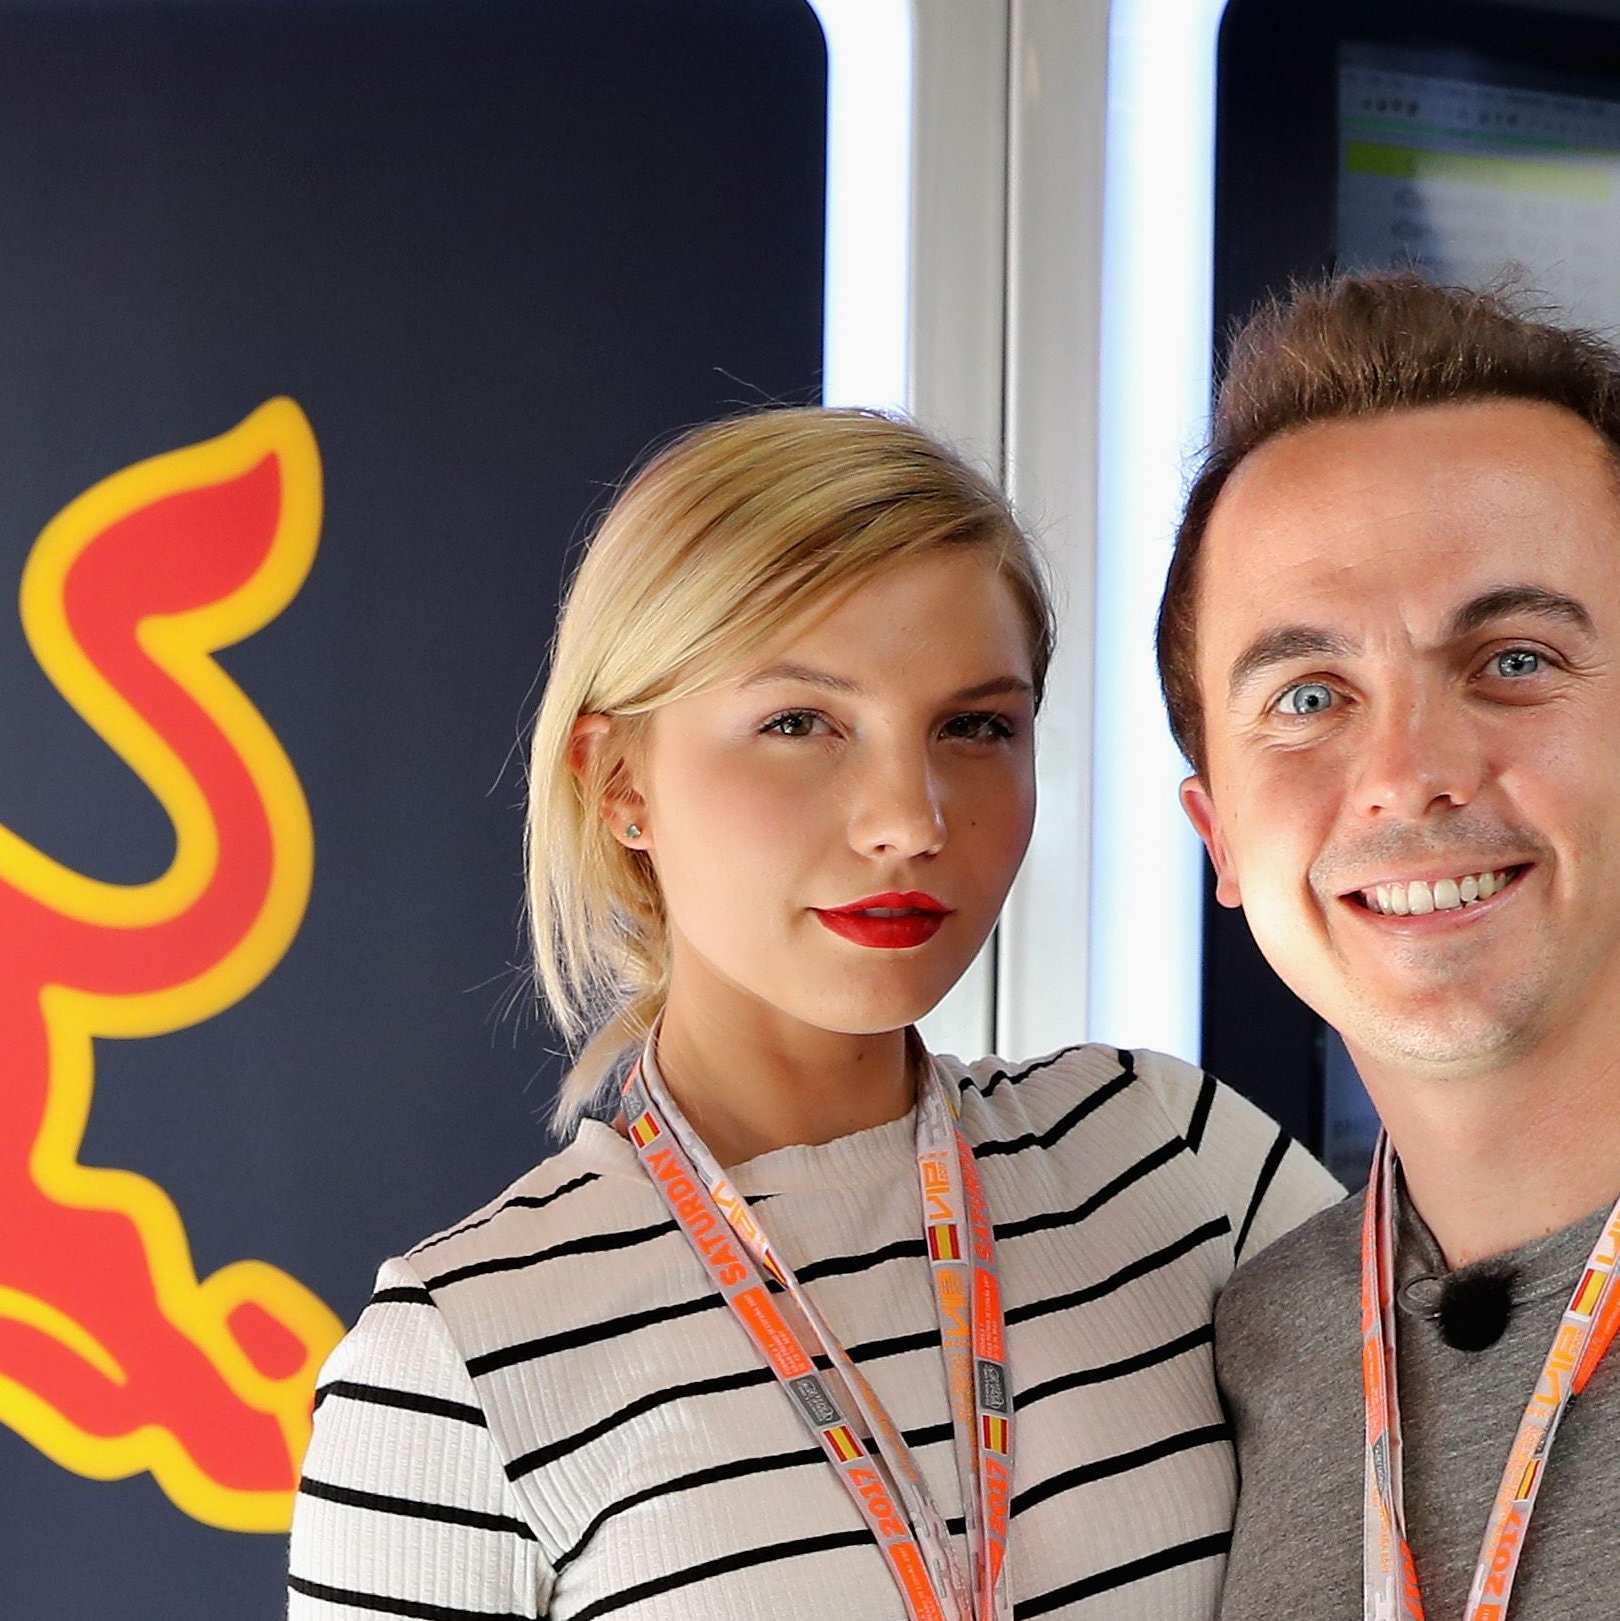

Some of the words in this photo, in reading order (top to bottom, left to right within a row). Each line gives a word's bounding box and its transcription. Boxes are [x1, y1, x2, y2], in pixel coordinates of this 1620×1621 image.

[645, 1147, 747, 1288] SATURDAY
[920, 1160, 956, 1222] VIP
[939, 1269, 970, 1338] VIP
[1532, 1326, 1577, 1408] VIP
[847, 1466, 907, 1537] 2017
[985, 1458, 1009, 1535] 2017
[1484, 1510, 1523, 1597] 2017
